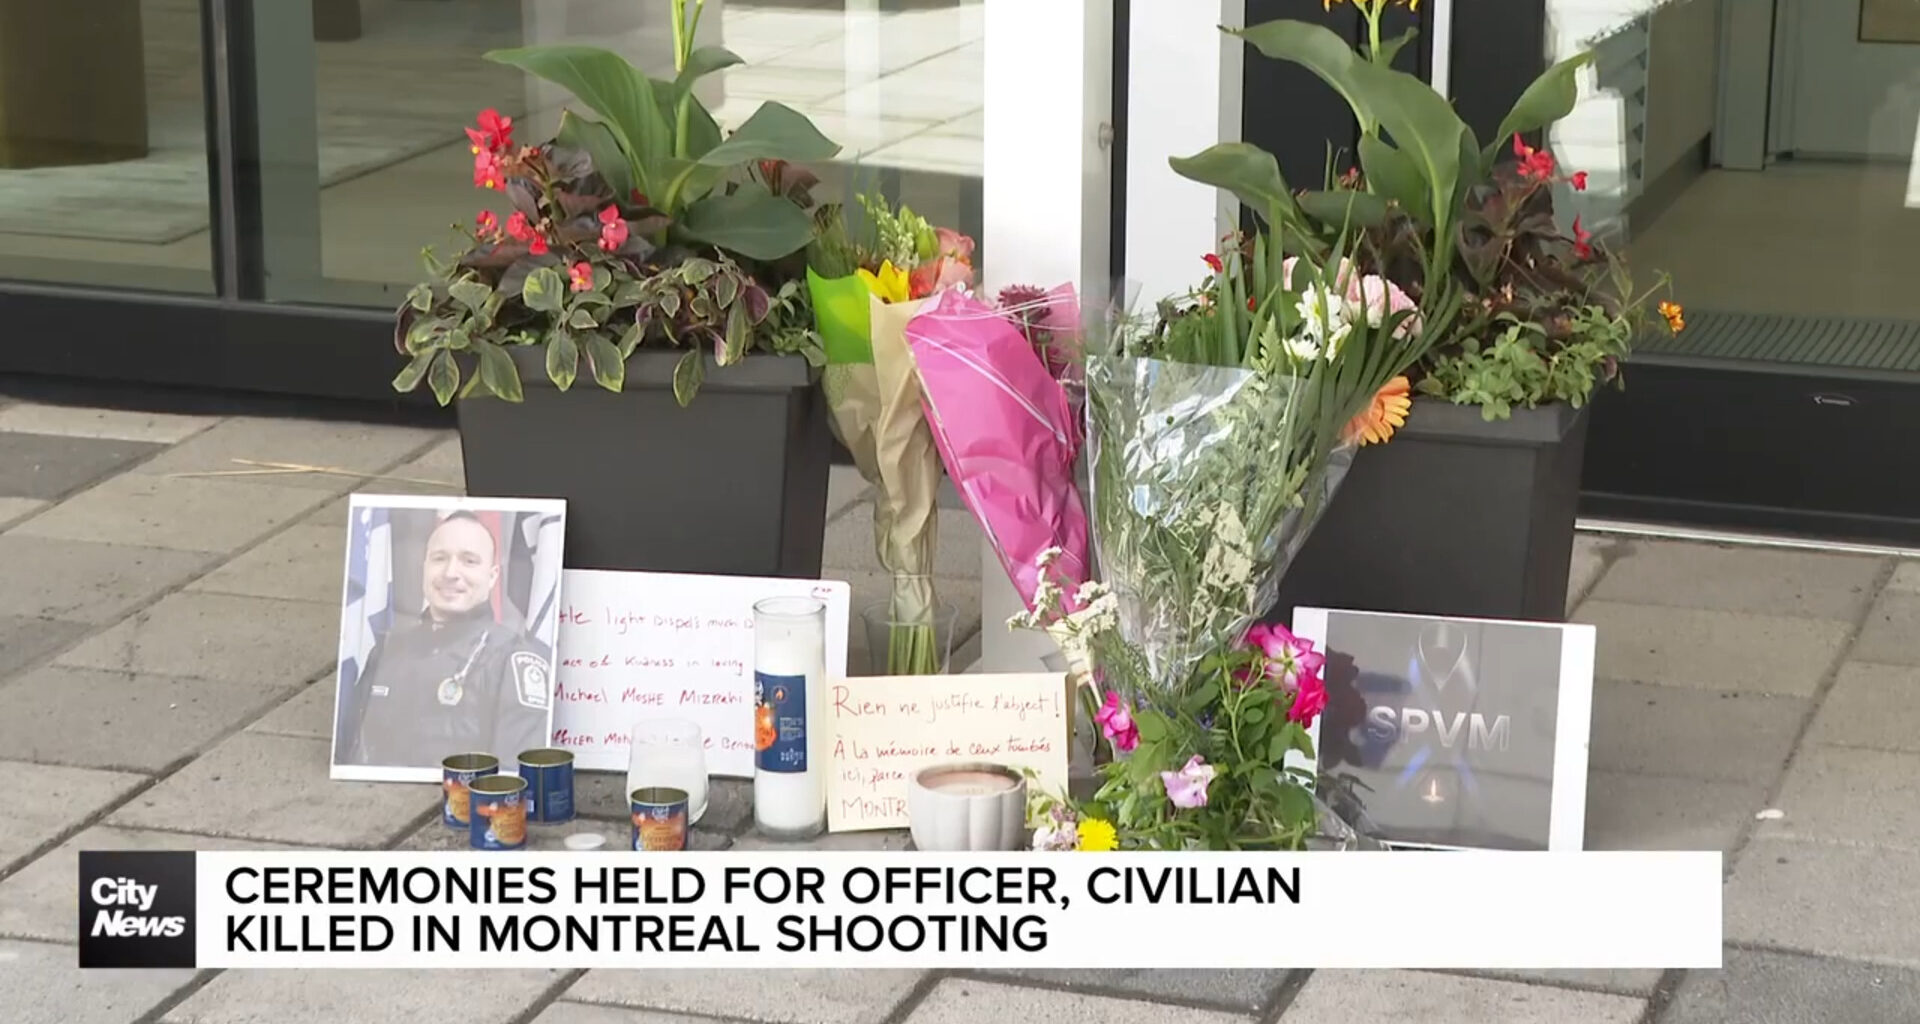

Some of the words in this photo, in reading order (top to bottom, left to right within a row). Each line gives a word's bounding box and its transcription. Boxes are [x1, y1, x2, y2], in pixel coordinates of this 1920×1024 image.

[832, 685, 886, 718] Rien
[900, 701, 920, 716] ne
[927, 692, 985, 723] justifie
[1368, 705, 1511, 752] SPVM
[853, 740, 869, 760] la
[876, 739, 936, 757] mémoire
[945, 739, 962, 756] de
